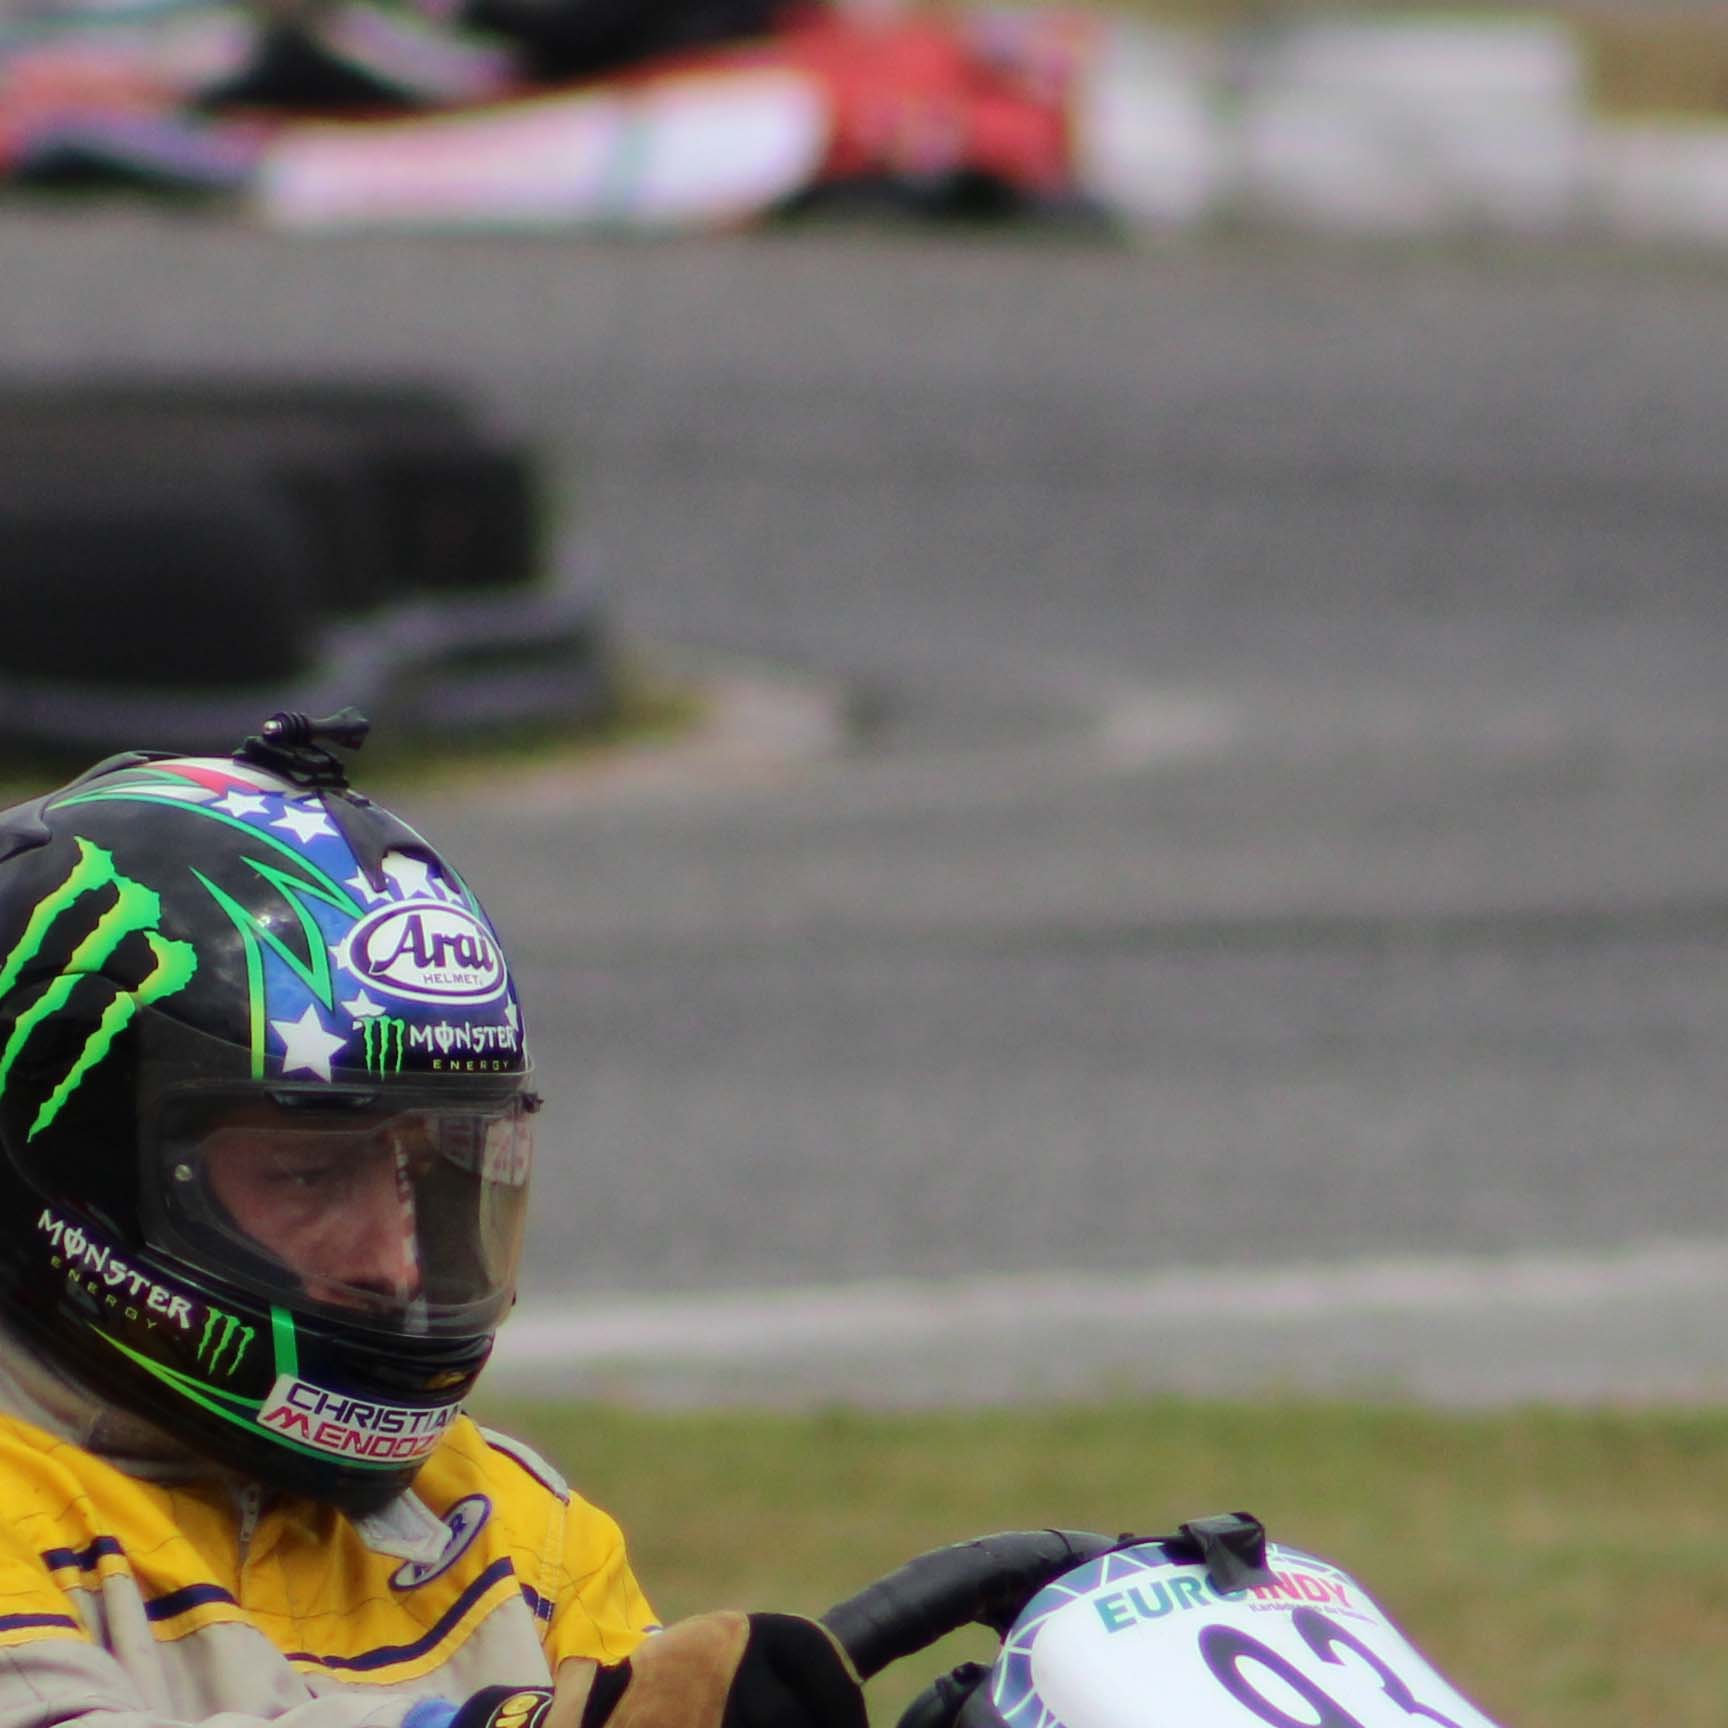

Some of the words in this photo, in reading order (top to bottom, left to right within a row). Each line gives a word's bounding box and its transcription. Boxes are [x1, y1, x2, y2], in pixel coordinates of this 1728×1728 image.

[370, 914, 495, 973] Arai
[431, 1058, 510, 1073] ENERGY
[49, 1254, 158, 1330] ENERGY
